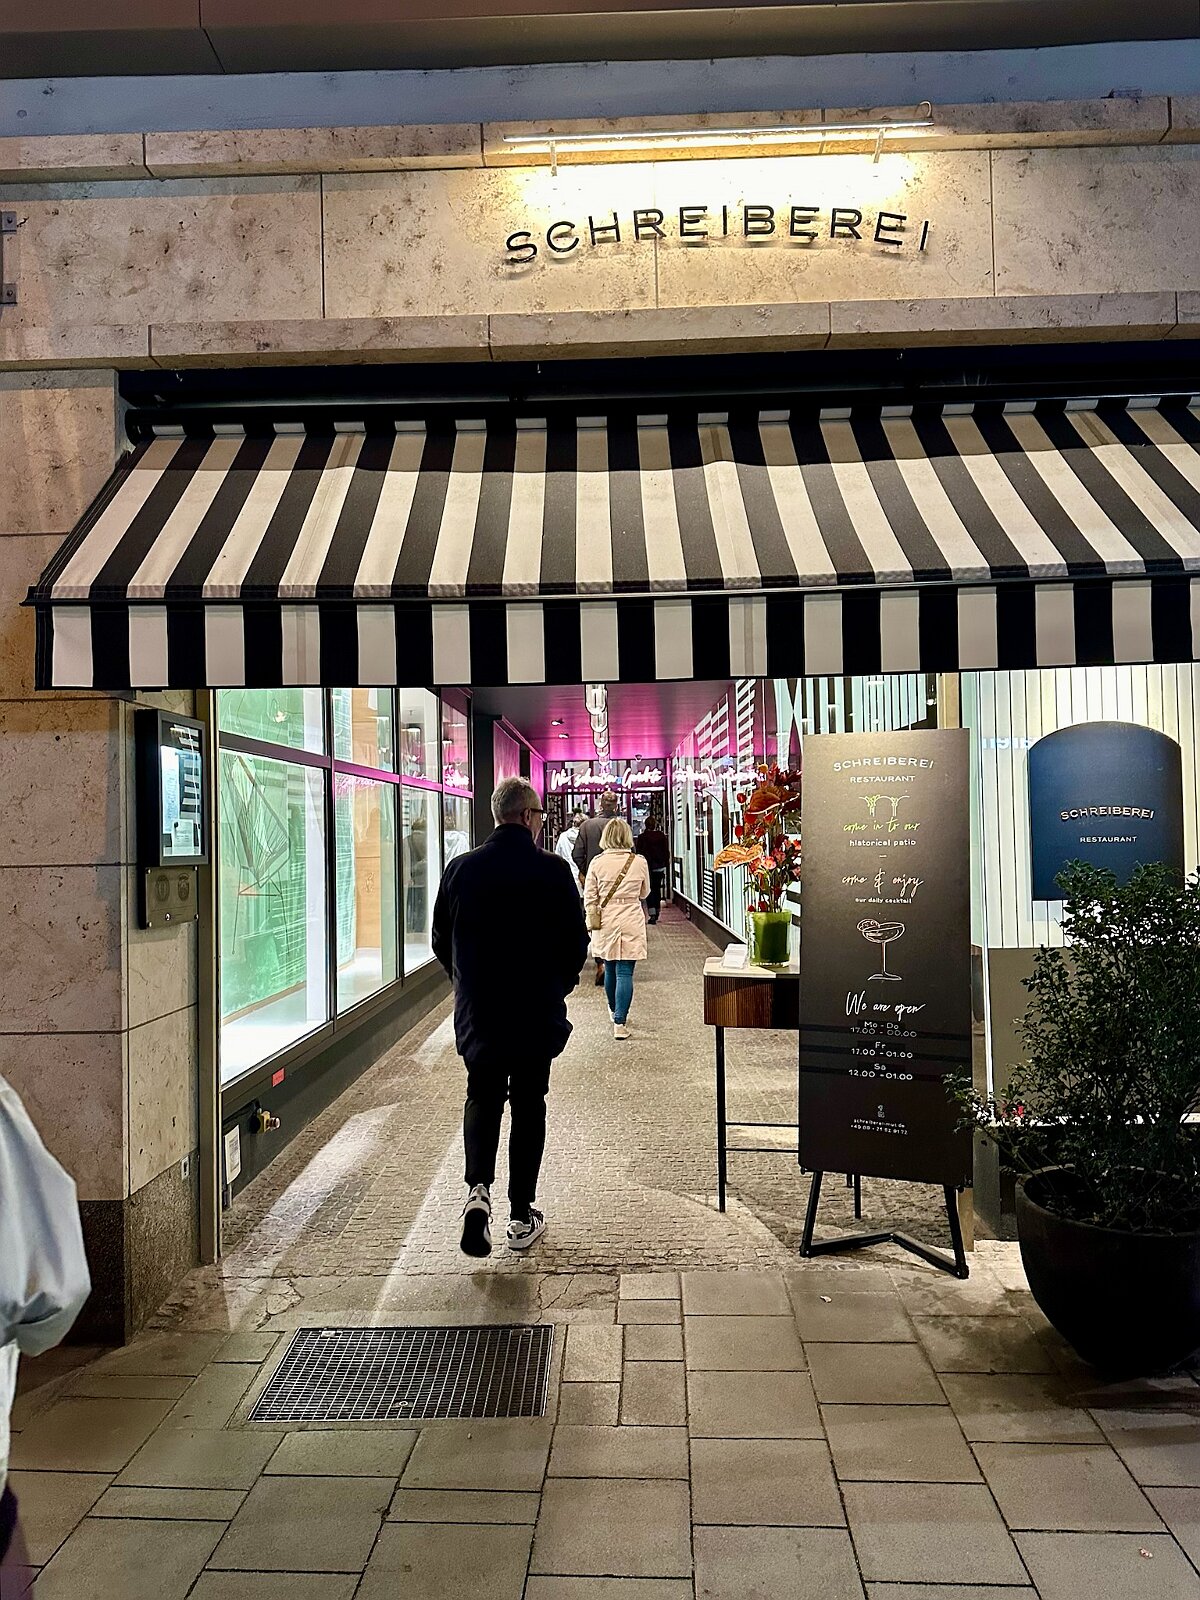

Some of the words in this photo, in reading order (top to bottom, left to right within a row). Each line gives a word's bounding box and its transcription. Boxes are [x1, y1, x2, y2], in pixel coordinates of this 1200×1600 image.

[506, 205, 929, 263] SCHREIBEREI
[833, 756, 934, 772] SCHREIBEREI
[850, 775, 915, 783] RESTAURANT
[1060, 805, 1155, 820] SCHREIBEREI
[843, 822, 868, 834] come
[873, 820, 884, 830] in
[886, 816, 900, 833] to
[904, 822, 921, 831] our
[849, 838, 891, 847] historical
[893, 838, 917, 847] patio
[841, 874, 868, 886] come
[873, 867, 886, 895] &
[892, 873, 925, 898] enjoy
[868, 896, 884, 905] daily
[885, 896, 913, 905] cocktail
[846, 990, 867, 1016] We
[872, 1003, 892, 1012] are
[894, 1003, 926, 1022] open
[850, 1026, 876, 1035] 17.00
[886, 1029, 918, 1038] 00.00
[886, 1022, 899, 1030] Do
[875, 1041, 886, 1049] Fr
[851, 1048, 876, 1056] 17.00
[885, 1050, 914, 1059] 01.00
[873, 1063, 887, 1071] Sa
[848, 1069, 876, 1077] 12.00
[885, 1072, 914, 1081] 01.00
